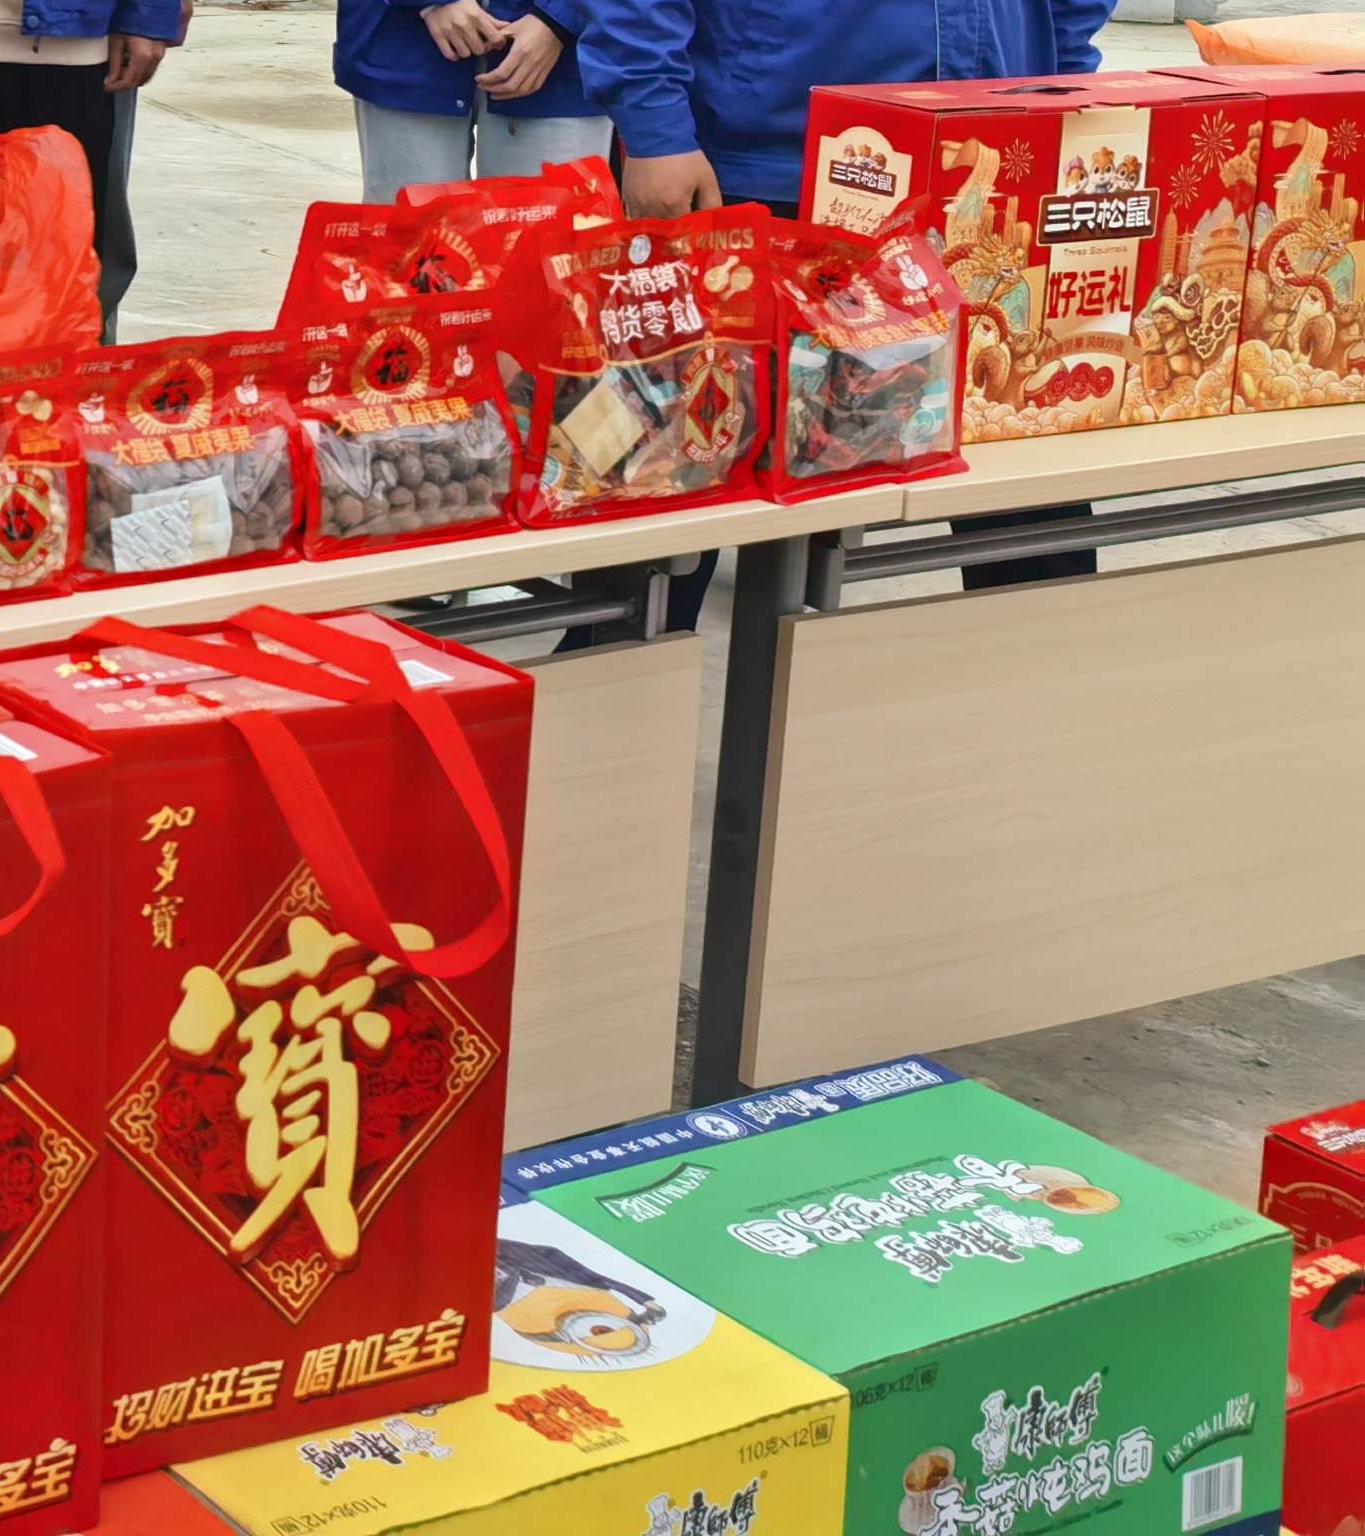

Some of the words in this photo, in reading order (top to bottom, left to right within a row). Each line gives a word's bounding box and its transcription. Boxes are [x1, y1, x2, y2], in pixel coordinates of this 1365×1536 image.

[831, 164, 893, 192] 三只松鼠
[1044, 196, 1151, 233] 三只松鼠
[1046, 265, 1131, 319] 好运礼
[333, 404, 390, 436] 大福袋
[396, 396, 473, 429] 夏威夷果
[111, 437, 170, 466] 大福袋
[170, 425, 255, 460] 夏威夷果
[142, 804, 195, 951] 加多寶
[168, 916, 435, 1262] 寶
[517, 1129, 693, 1179] 中国航天事业合作伙伴
[105, 1360, 284, 1445] 招财进宝
[293, 1309, 466, 1401] 喝加多宝
